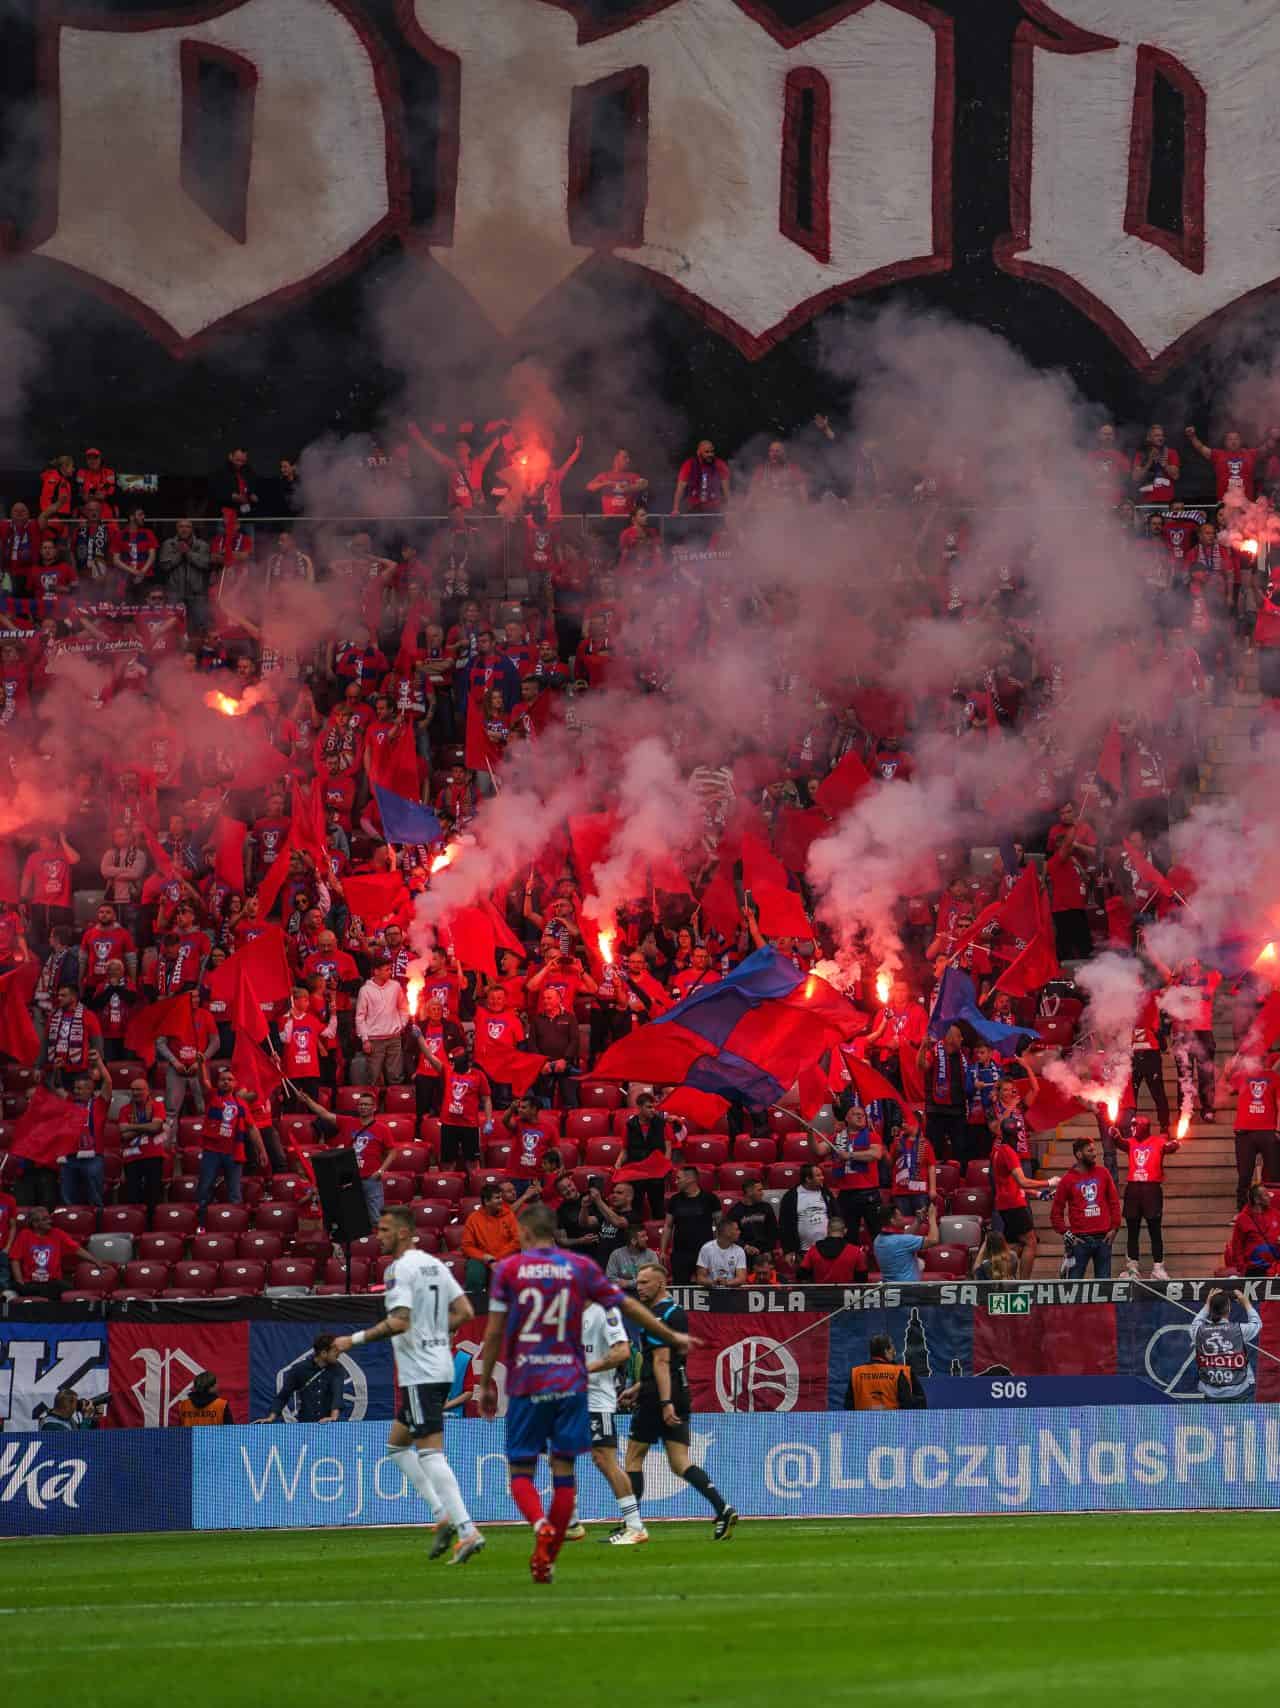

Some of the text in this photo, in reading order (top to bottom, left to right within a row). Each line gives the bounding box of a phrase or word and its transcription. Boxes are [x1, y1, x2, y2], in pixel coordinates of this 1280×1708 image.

[518, 1263, 572, 1280] ARSENIĆ
[748, 1290, 805, 1312] DLA
[844, 1288, 900, 1309] NAS
[1166, 1281, 1205, 1300] BY
[518, 1287, 570, 1342] 24
[527, 1354, 573, 1365] TAURON
[9, 1341, 100, 1431] K
[991, 1381, 1027, 1399] S06
[240, 1444, 420, 1518] Wejd
